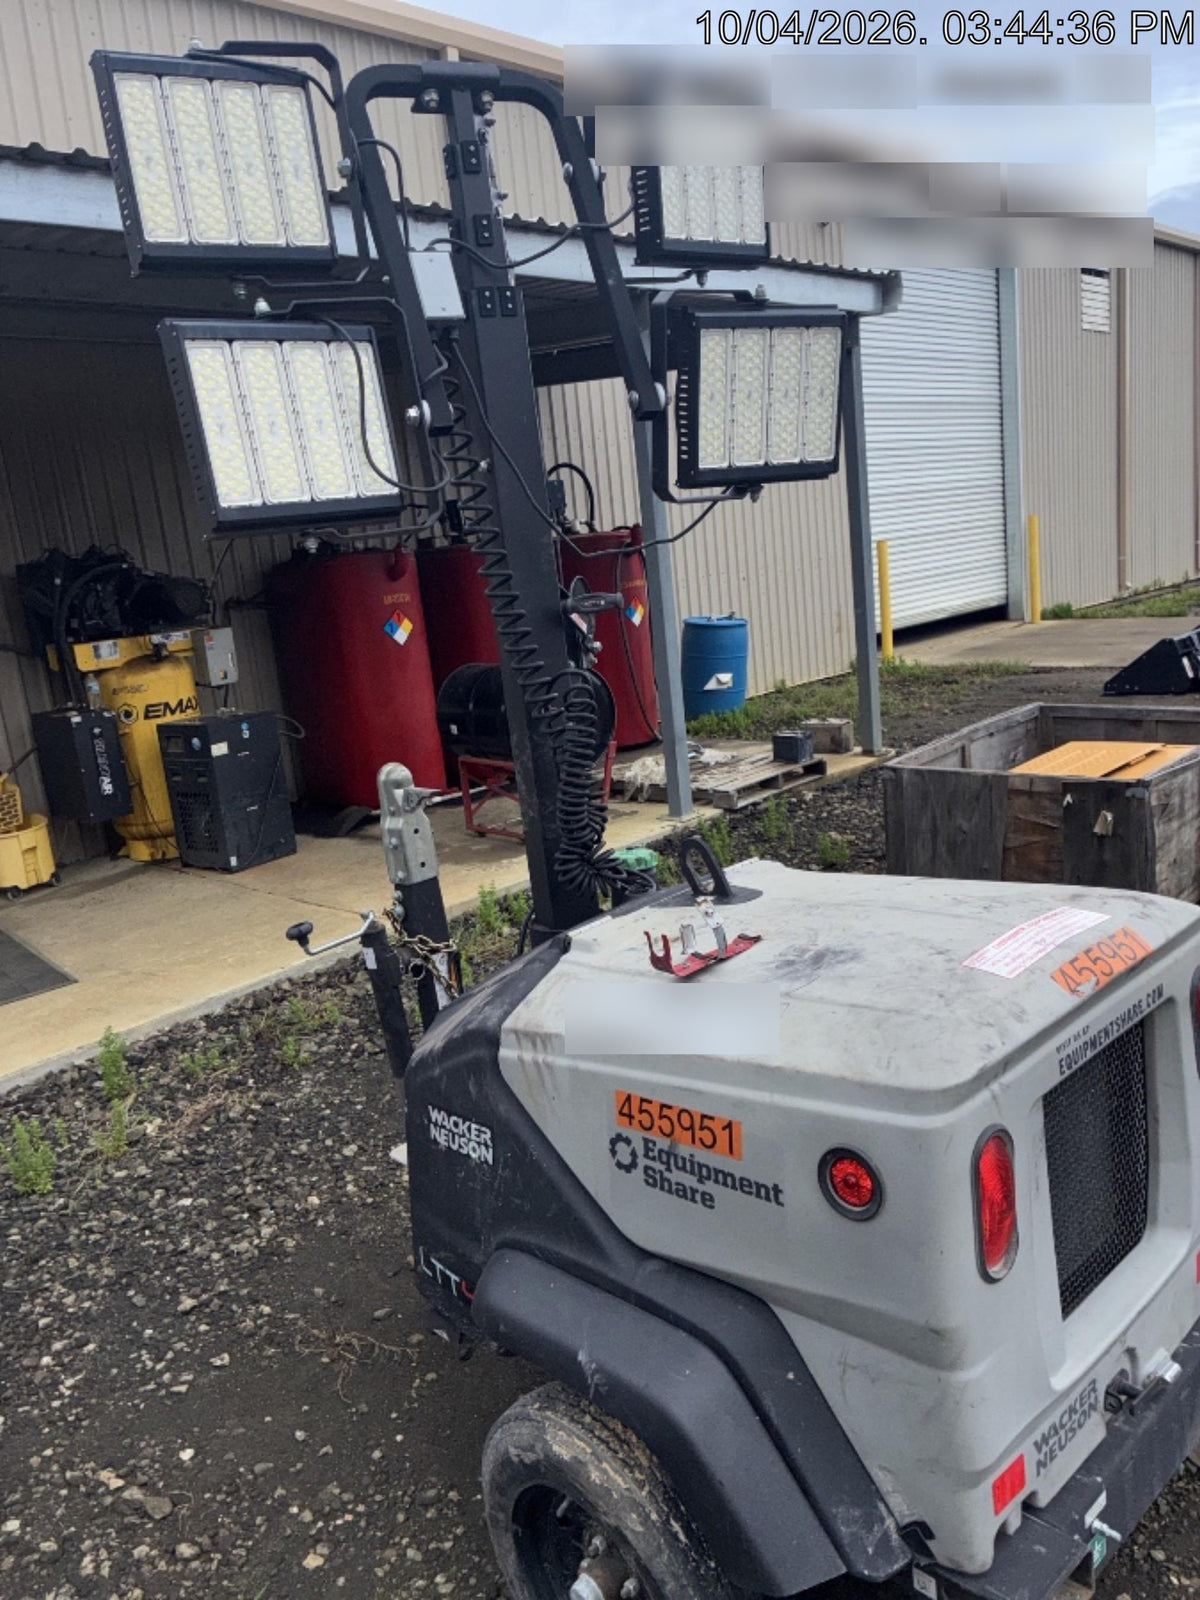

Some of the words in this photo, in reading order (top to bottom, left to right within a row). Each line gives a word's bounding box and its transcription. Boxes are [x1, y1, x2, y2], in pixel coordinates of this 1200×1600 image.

[1056, 928, 1151, 994] 455951
[1058, 983, 1165, 1076] EQUIPMENTSHARE.COM
[427, 1104, 494, 1148] WACKER
[428, 1124, 494, 1166] NEUSON
[617, 1092, 736, 1157] 455951
[643, 1136, 785, 1208] Equipment
[643, 1166, 716, 1210] Share
[1033, 1378, 1098, 1455] WACKER
[1035, 1394, 1099, 1478] NEUSON
